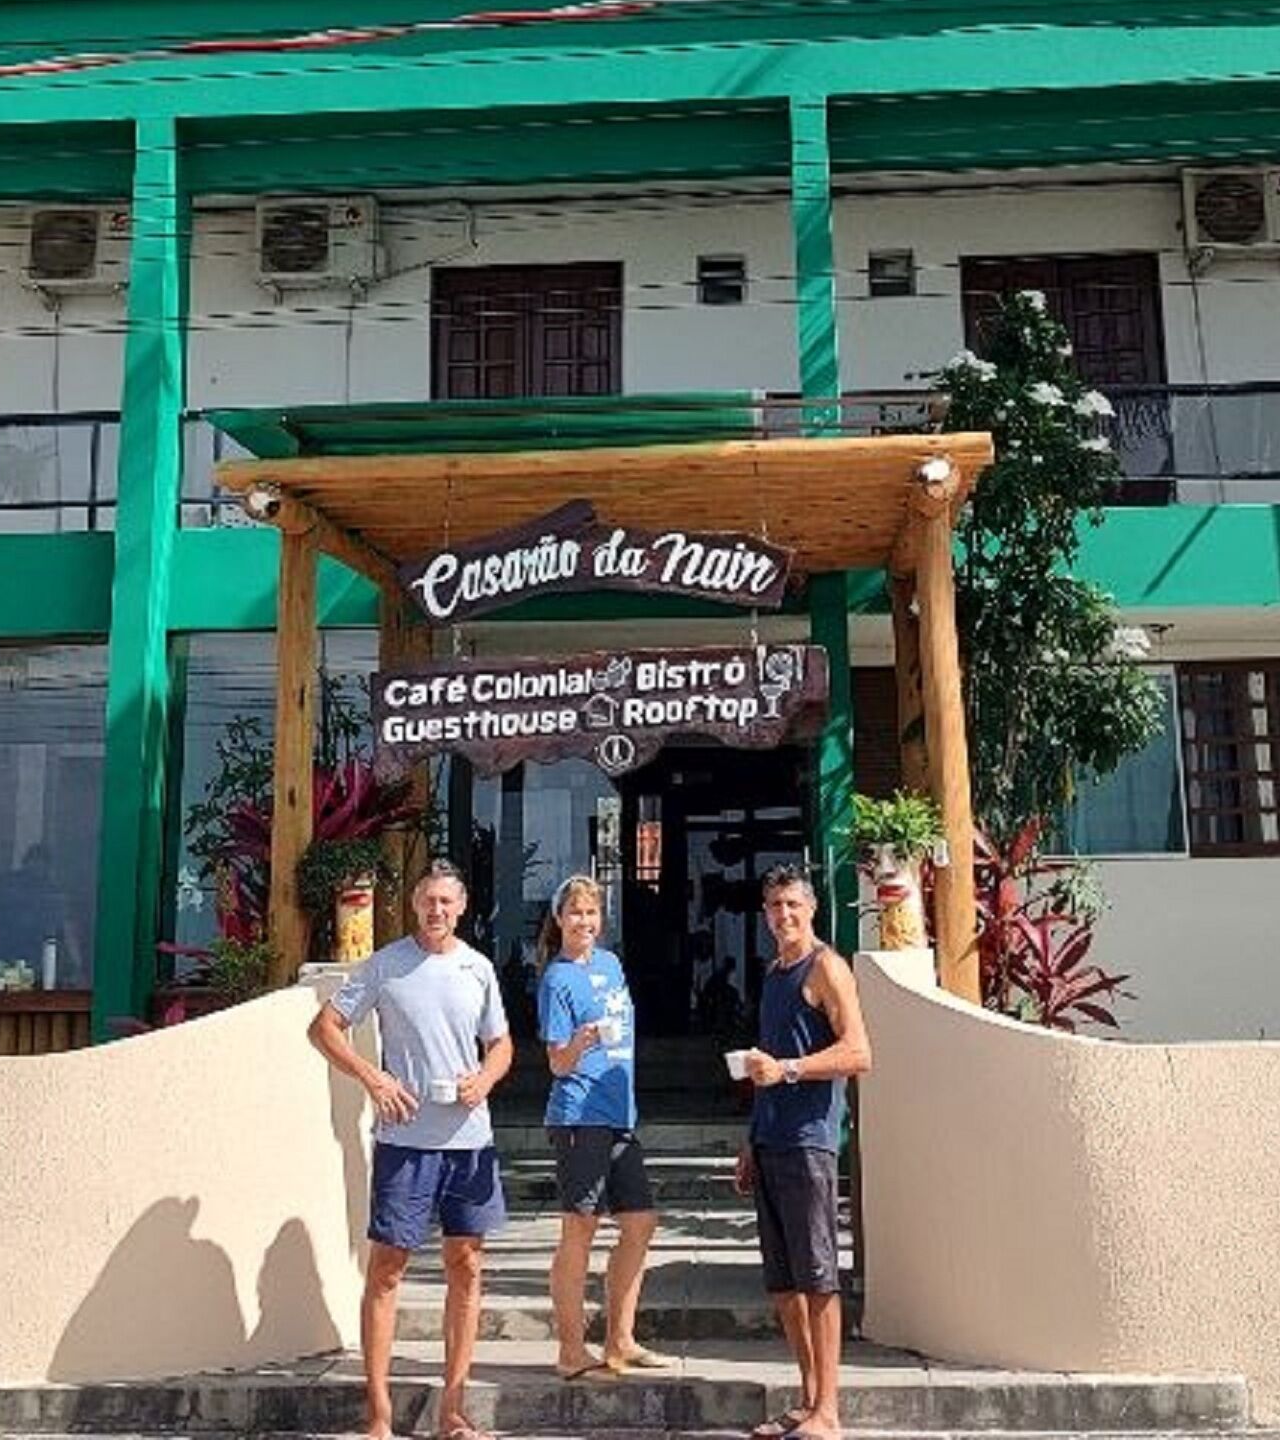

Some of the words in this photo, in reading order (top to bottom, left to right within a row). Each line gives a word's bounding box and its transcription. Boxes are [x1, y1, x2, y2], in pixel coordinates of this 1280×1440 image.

[410, 534, 581, 618] Casarão
[592, 528, 650, 577] da
[652, 532, 779, 593] Nair
[384, 673, 468, 707] Café
[472, 668, 593, 702] Colonial
[382, 709, 577, 743] Guesthouse
[623, 694, 758, 727] Rooftop
